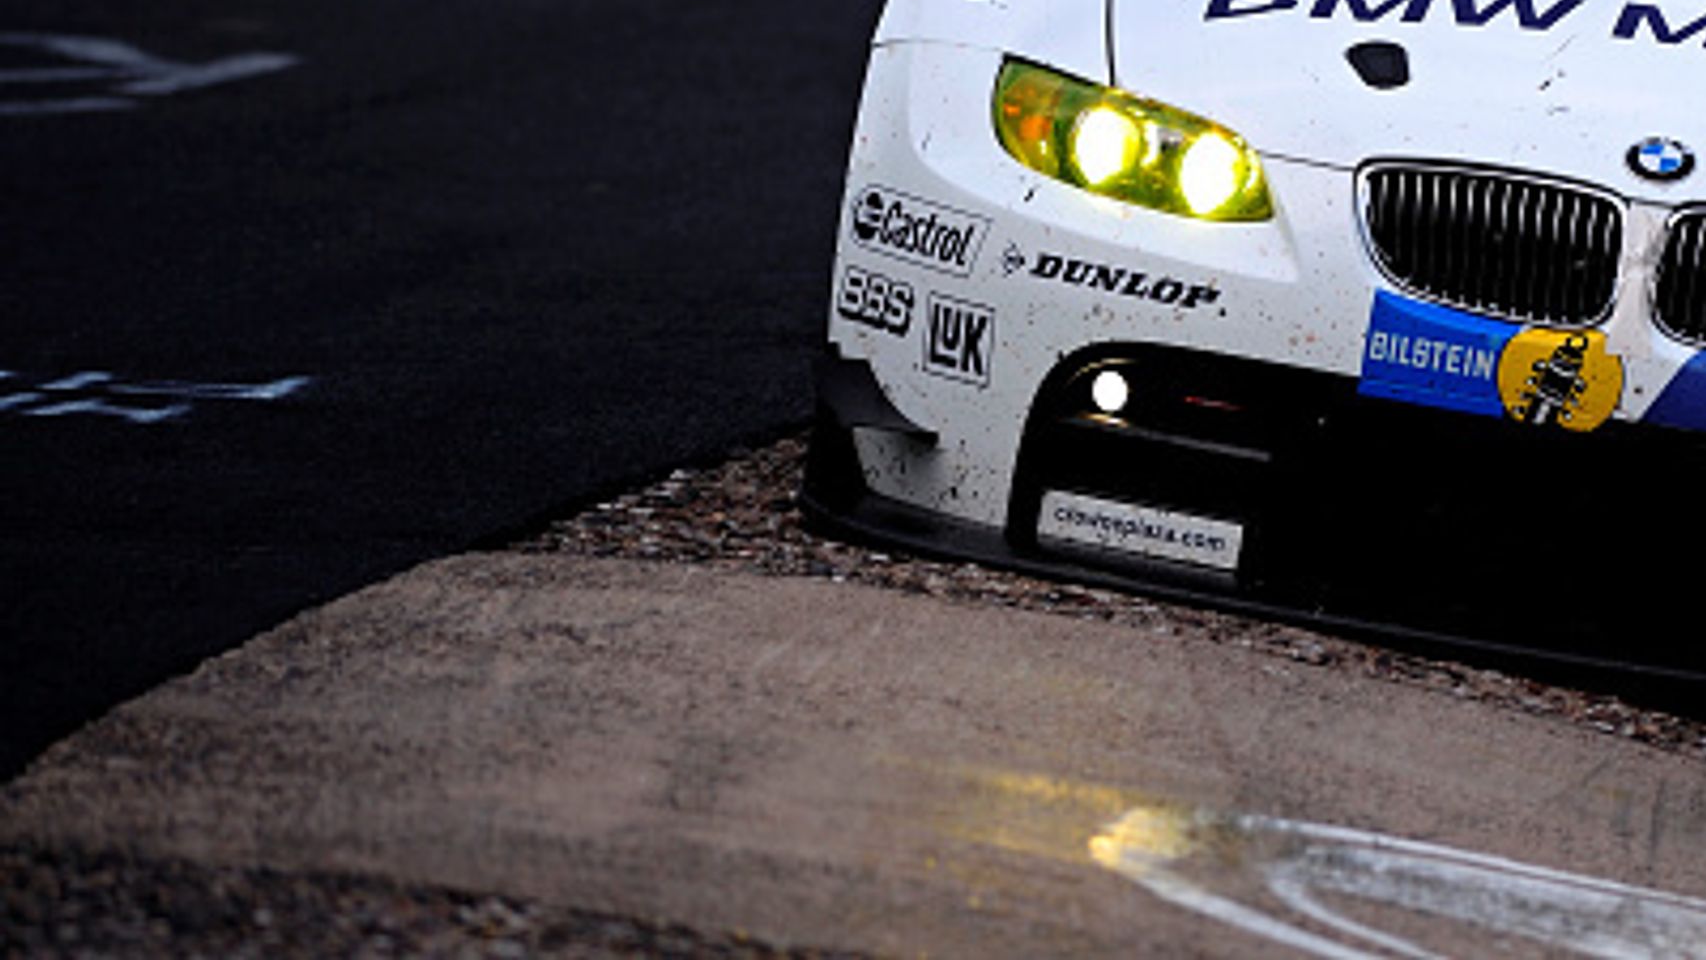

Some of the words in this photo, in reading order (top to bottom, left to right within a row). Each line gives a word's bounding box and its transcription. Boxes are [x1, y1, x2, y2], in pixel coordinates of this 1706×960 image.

[880, 200, 975, 267] Castrol
[838, 265, 914, 338] BBS
[1030, 254, 1221, 308] DUNLOP
[1368, 331, 1495, 380] BILSTEIN
